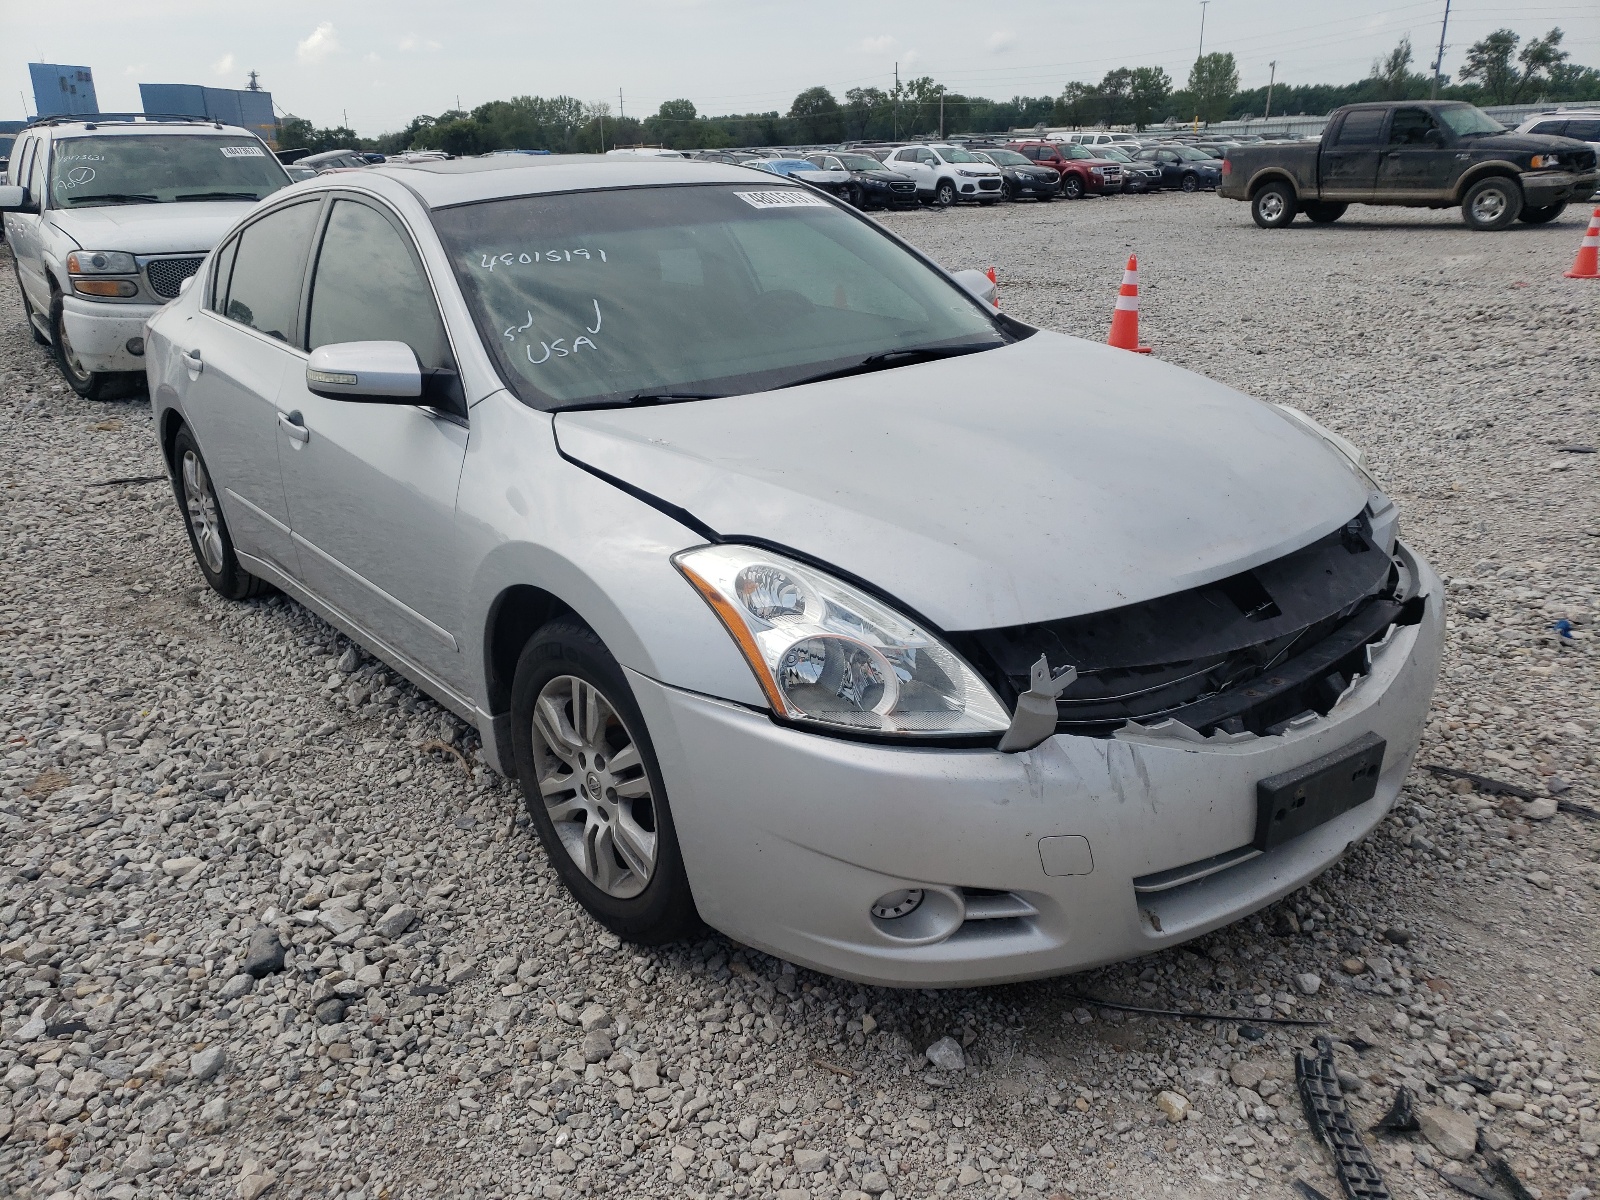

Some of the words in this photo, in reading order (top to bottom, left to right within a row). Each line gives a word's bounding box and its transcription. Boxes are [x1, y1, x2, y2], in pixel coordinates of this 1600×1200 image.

[747, 192, 813, 204] 48015191
[480, 248, 607, 272] 48015191
[526, 336, 598, 364] USA
